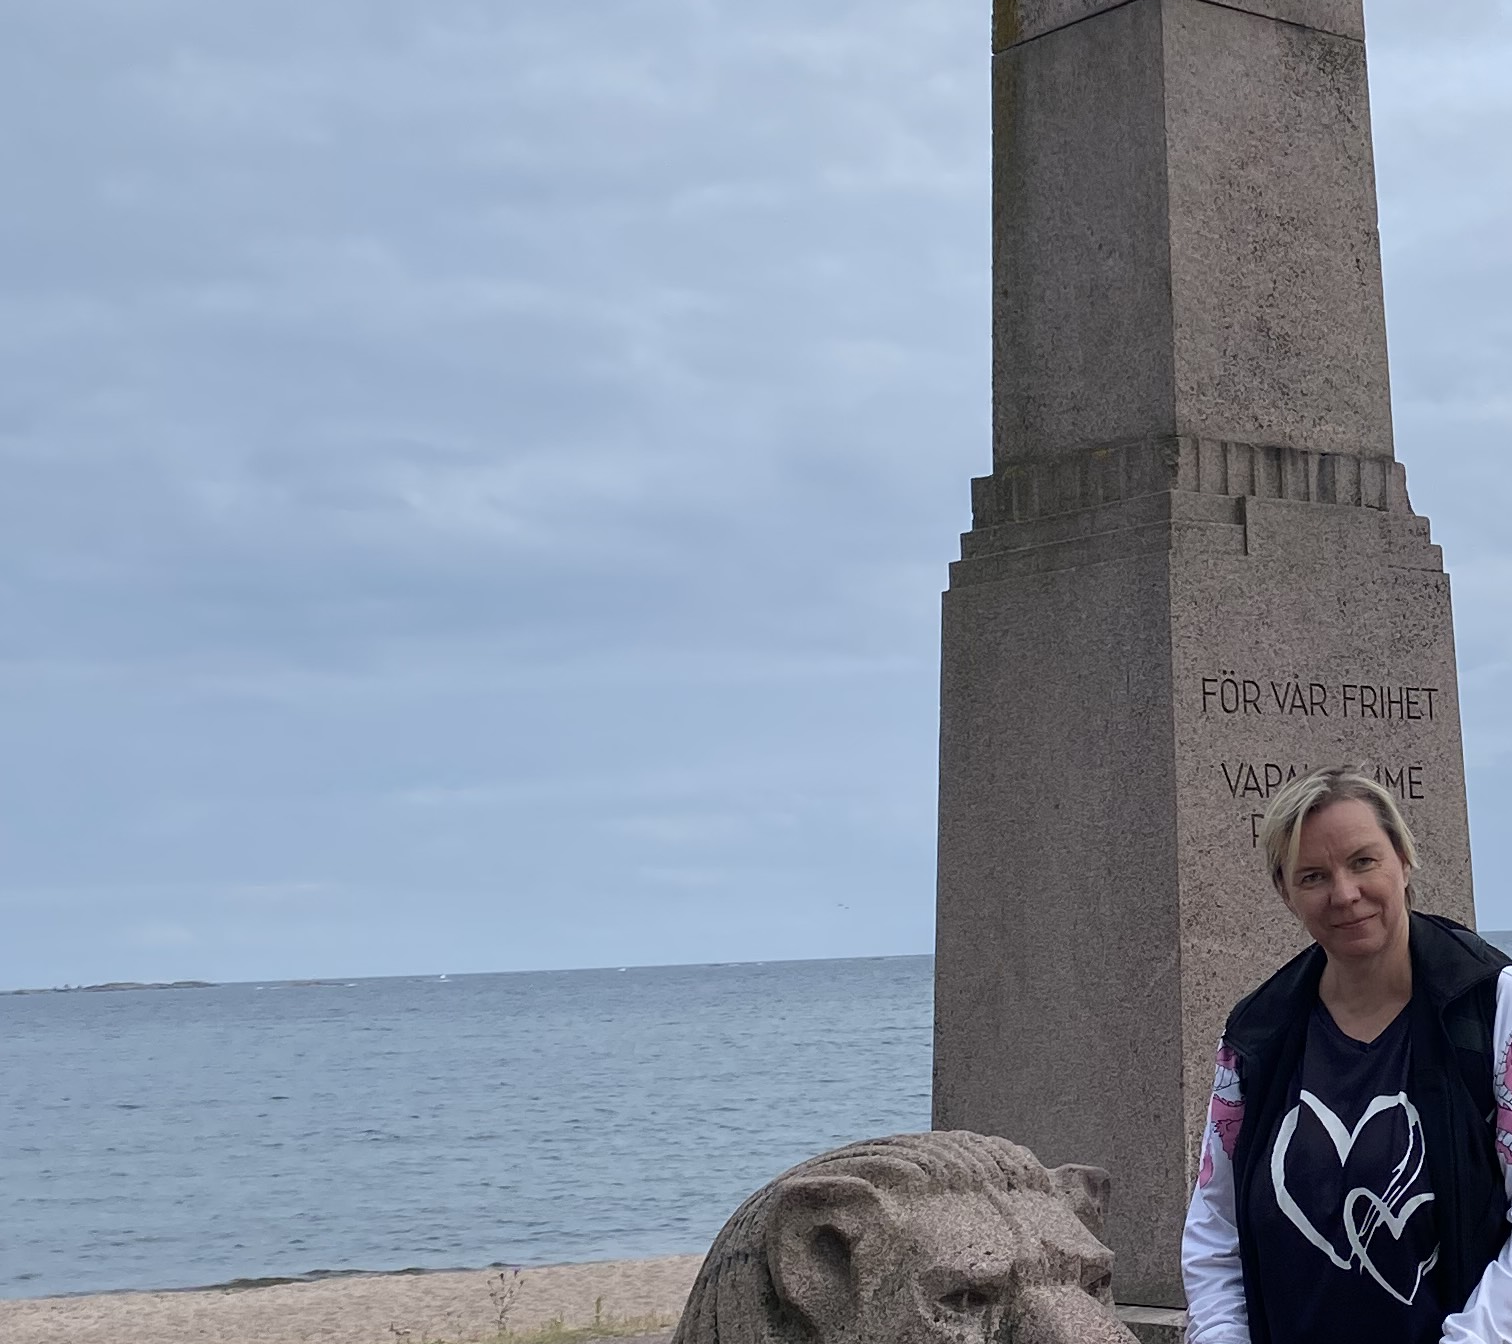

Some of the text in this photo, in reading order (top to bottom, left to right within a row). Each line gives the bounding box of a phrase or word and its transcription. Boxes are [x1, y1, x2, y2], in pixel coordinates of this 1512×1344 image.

[1201, 669, 1439, 721] FÖR VÅR FRIHET
[1220, 761, 1425, 800] VAPAME
